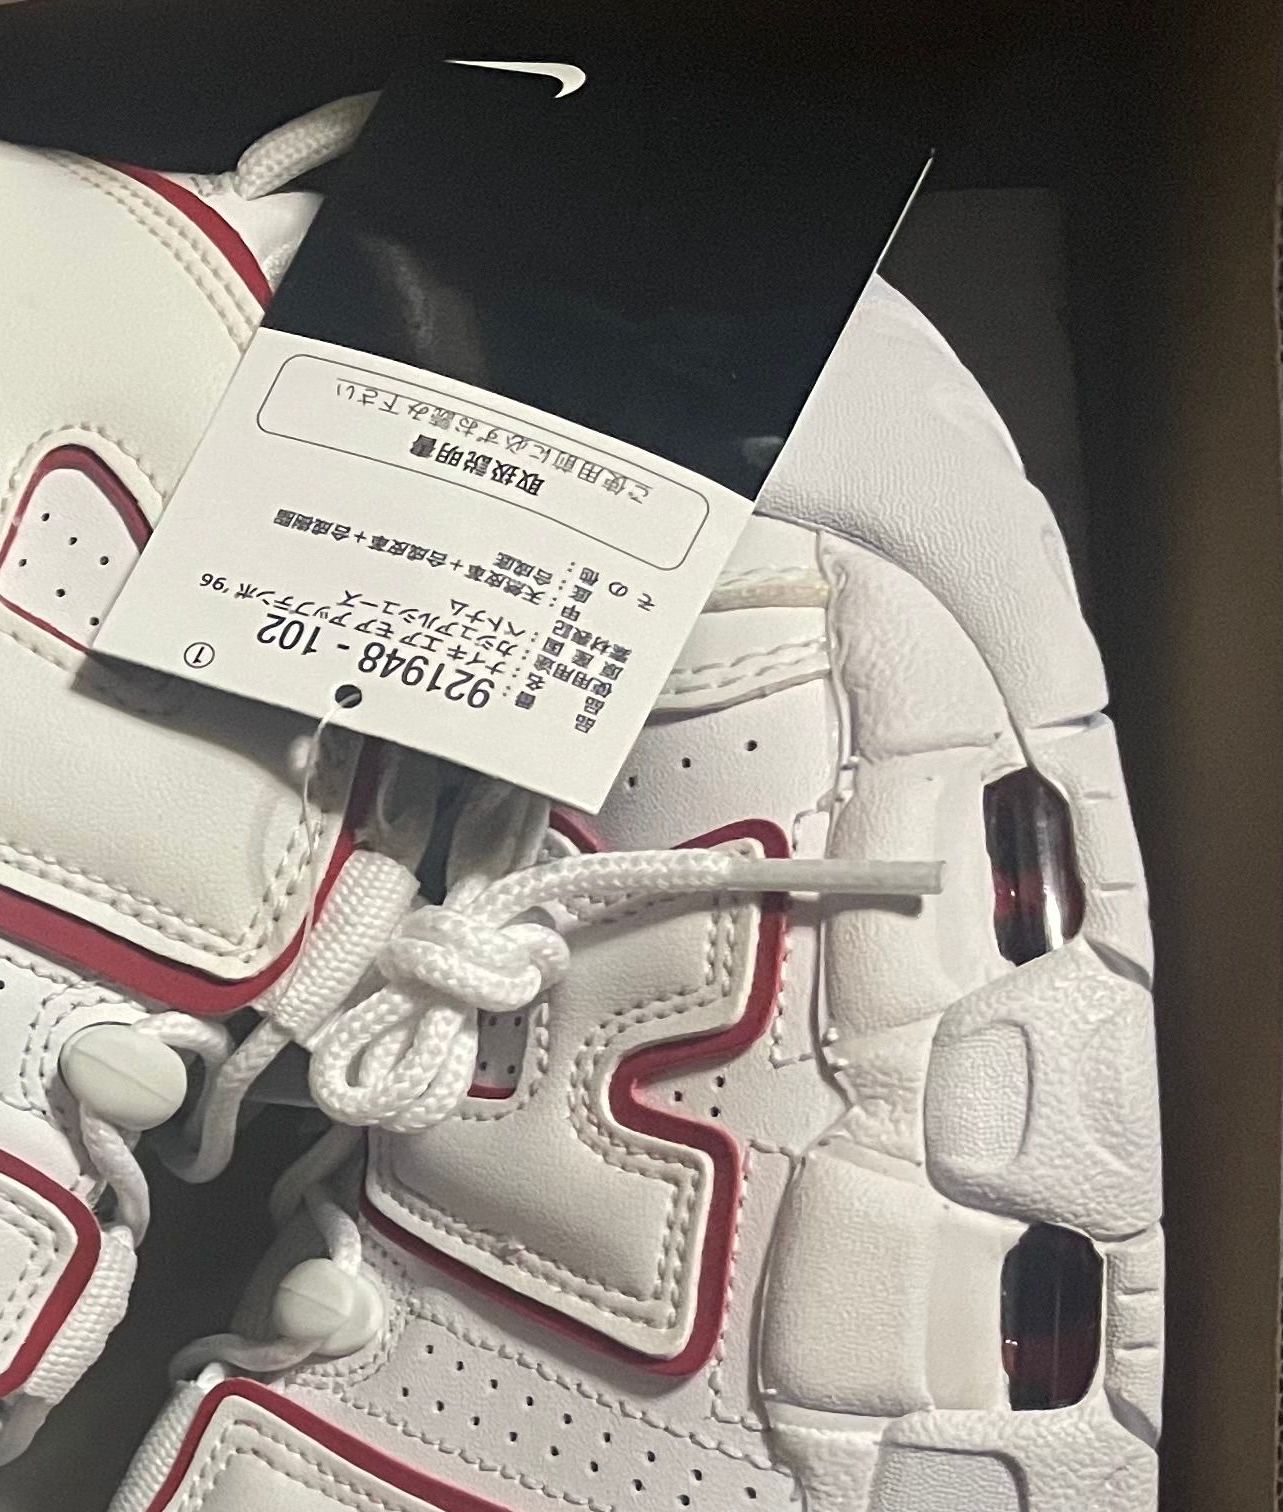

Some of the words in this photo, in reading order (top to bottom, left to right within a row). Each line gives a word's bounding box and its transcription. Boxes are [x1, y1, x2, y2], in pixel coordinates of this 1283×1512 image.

[335, 381, 652, 504] ご使用前に必ずお読み下さい
[409, 434, 546, 497] 取扱説明書
[198, 572, 230, 594] '96
[256, 612, 323, 656] 102
[354, 618, 396, 639] モア
[449, 598, 527, 638] ベトナム
[398, 631, 445, 653] エア
[446, 644, 506, 675] ナイキ
[357, 641, 496, 709] 921948
